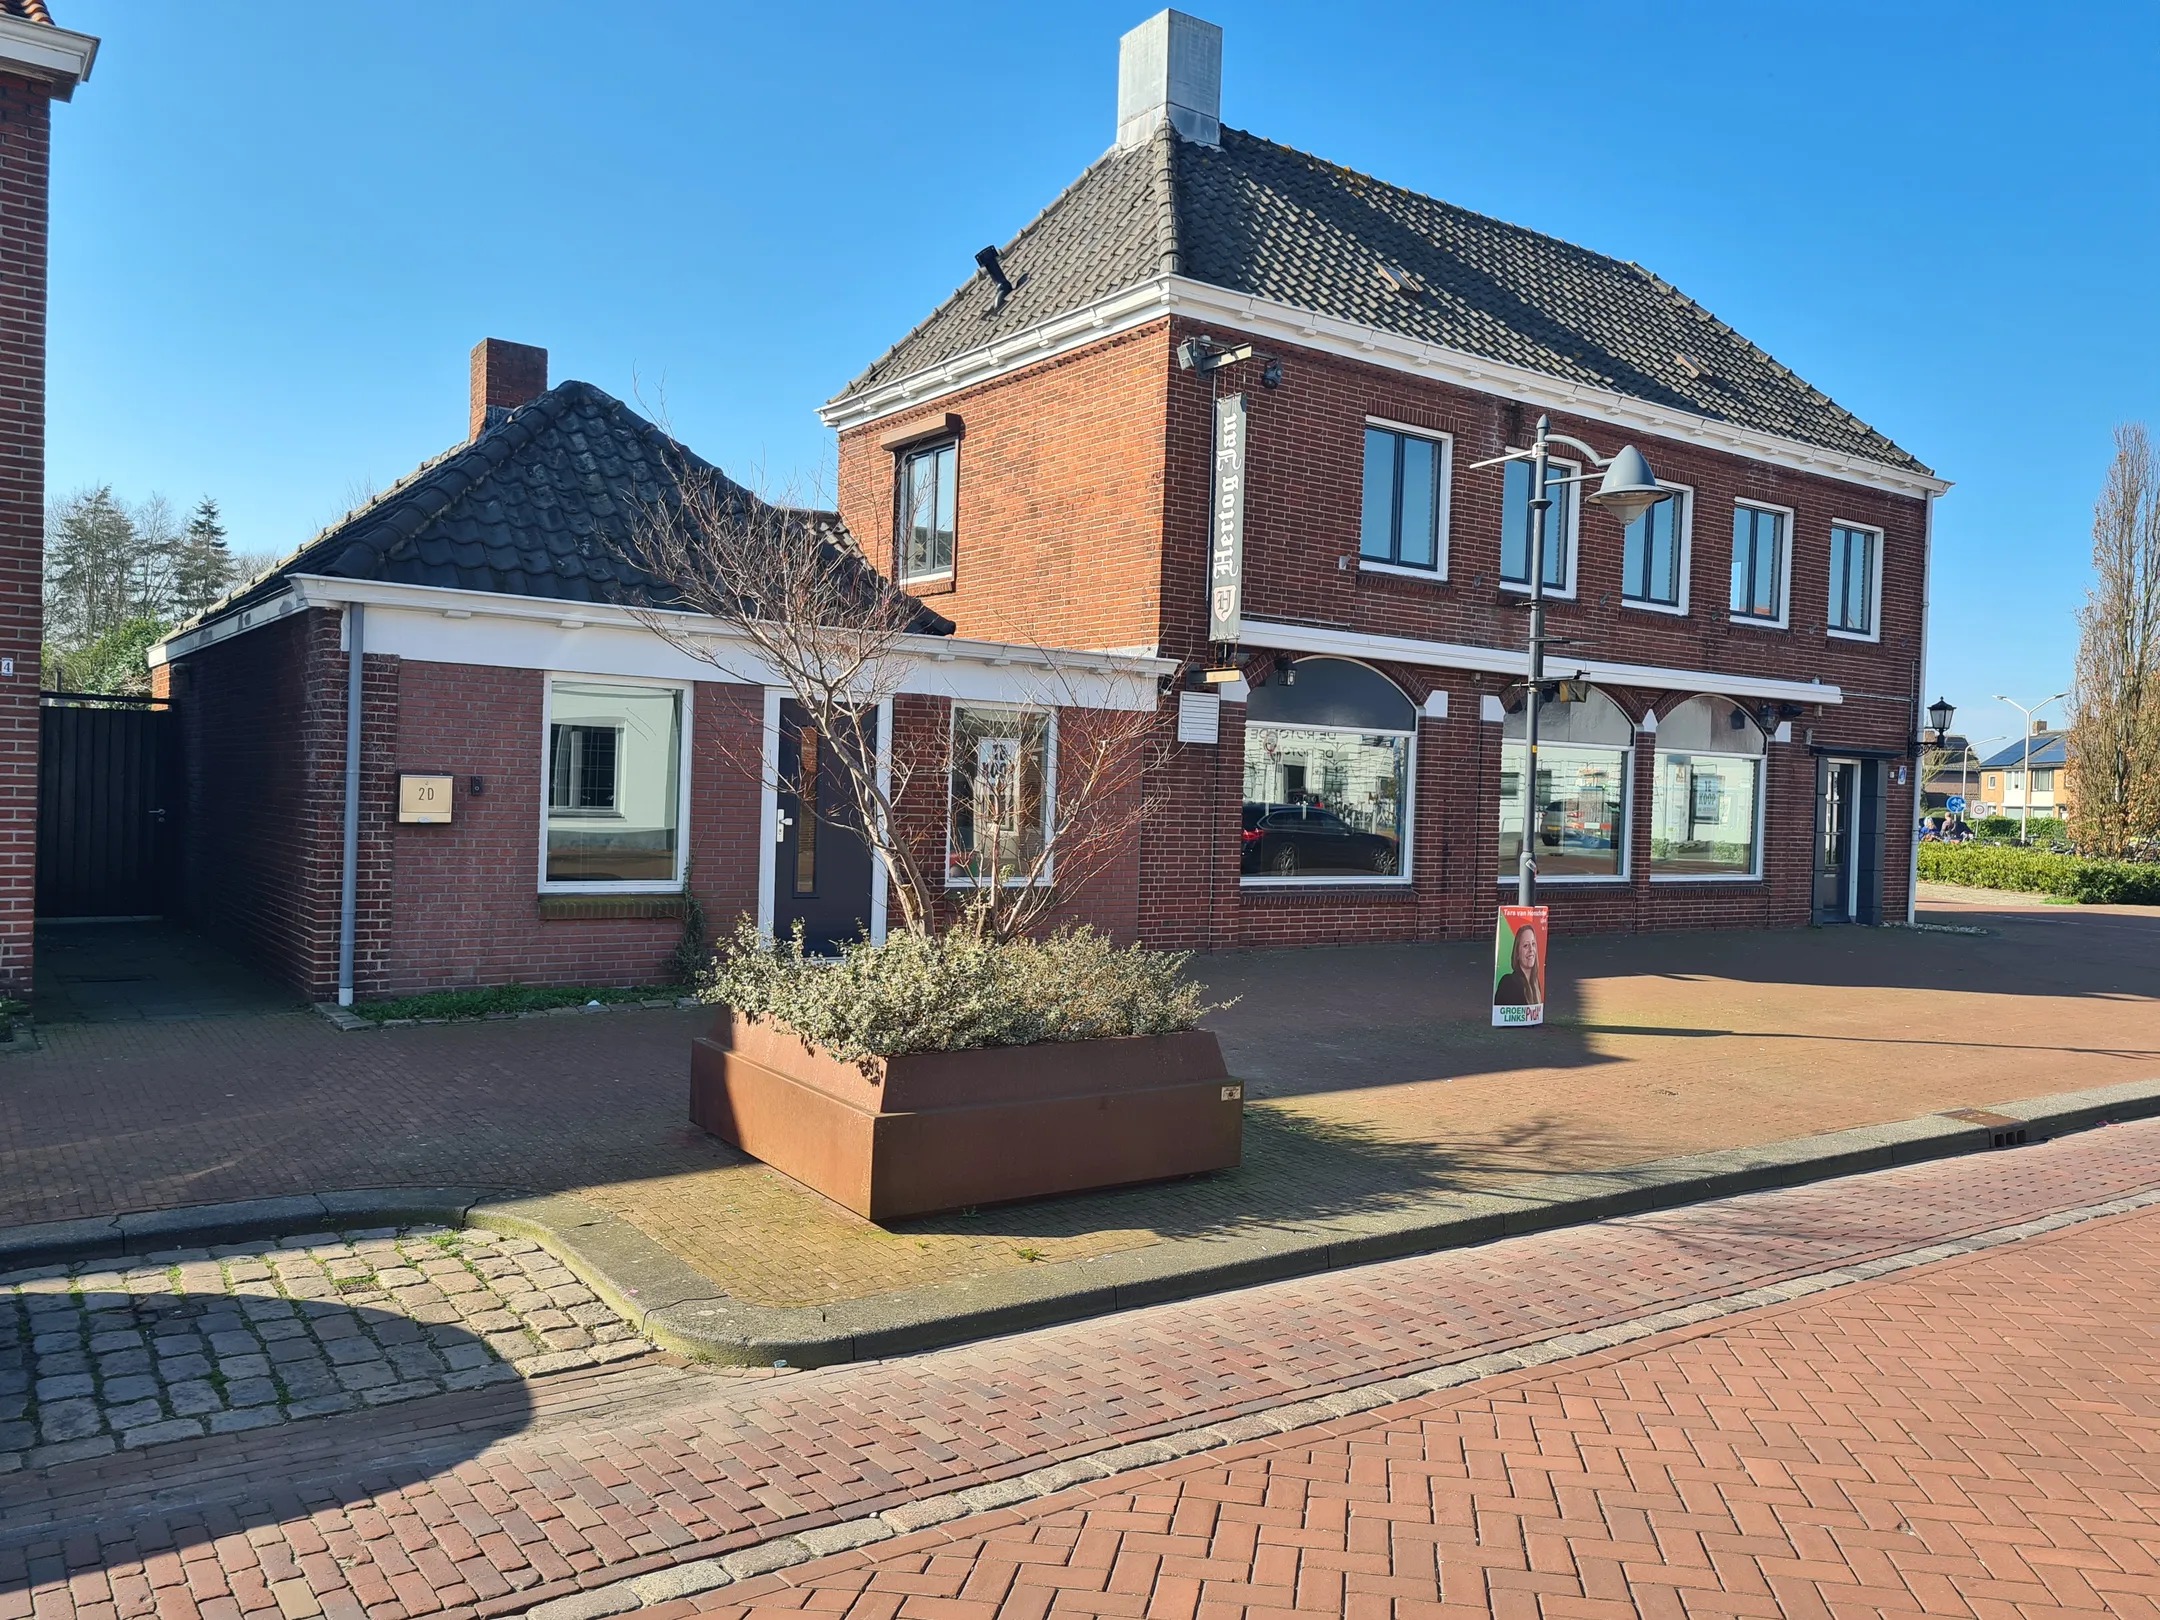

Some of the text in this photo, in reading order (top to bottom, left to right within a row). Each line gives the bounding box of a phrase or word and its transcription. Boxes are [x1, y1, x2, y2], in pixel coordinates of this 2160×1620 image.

[1213, 412, 1242, 578] Hertog Jan
[4, 662, 11, 672] 4
[418, 787, 434, 801] 2D
[1500, 1006, 1526, 1015] GROEN
[1504, 1014, 1526, 1022] LINKS
